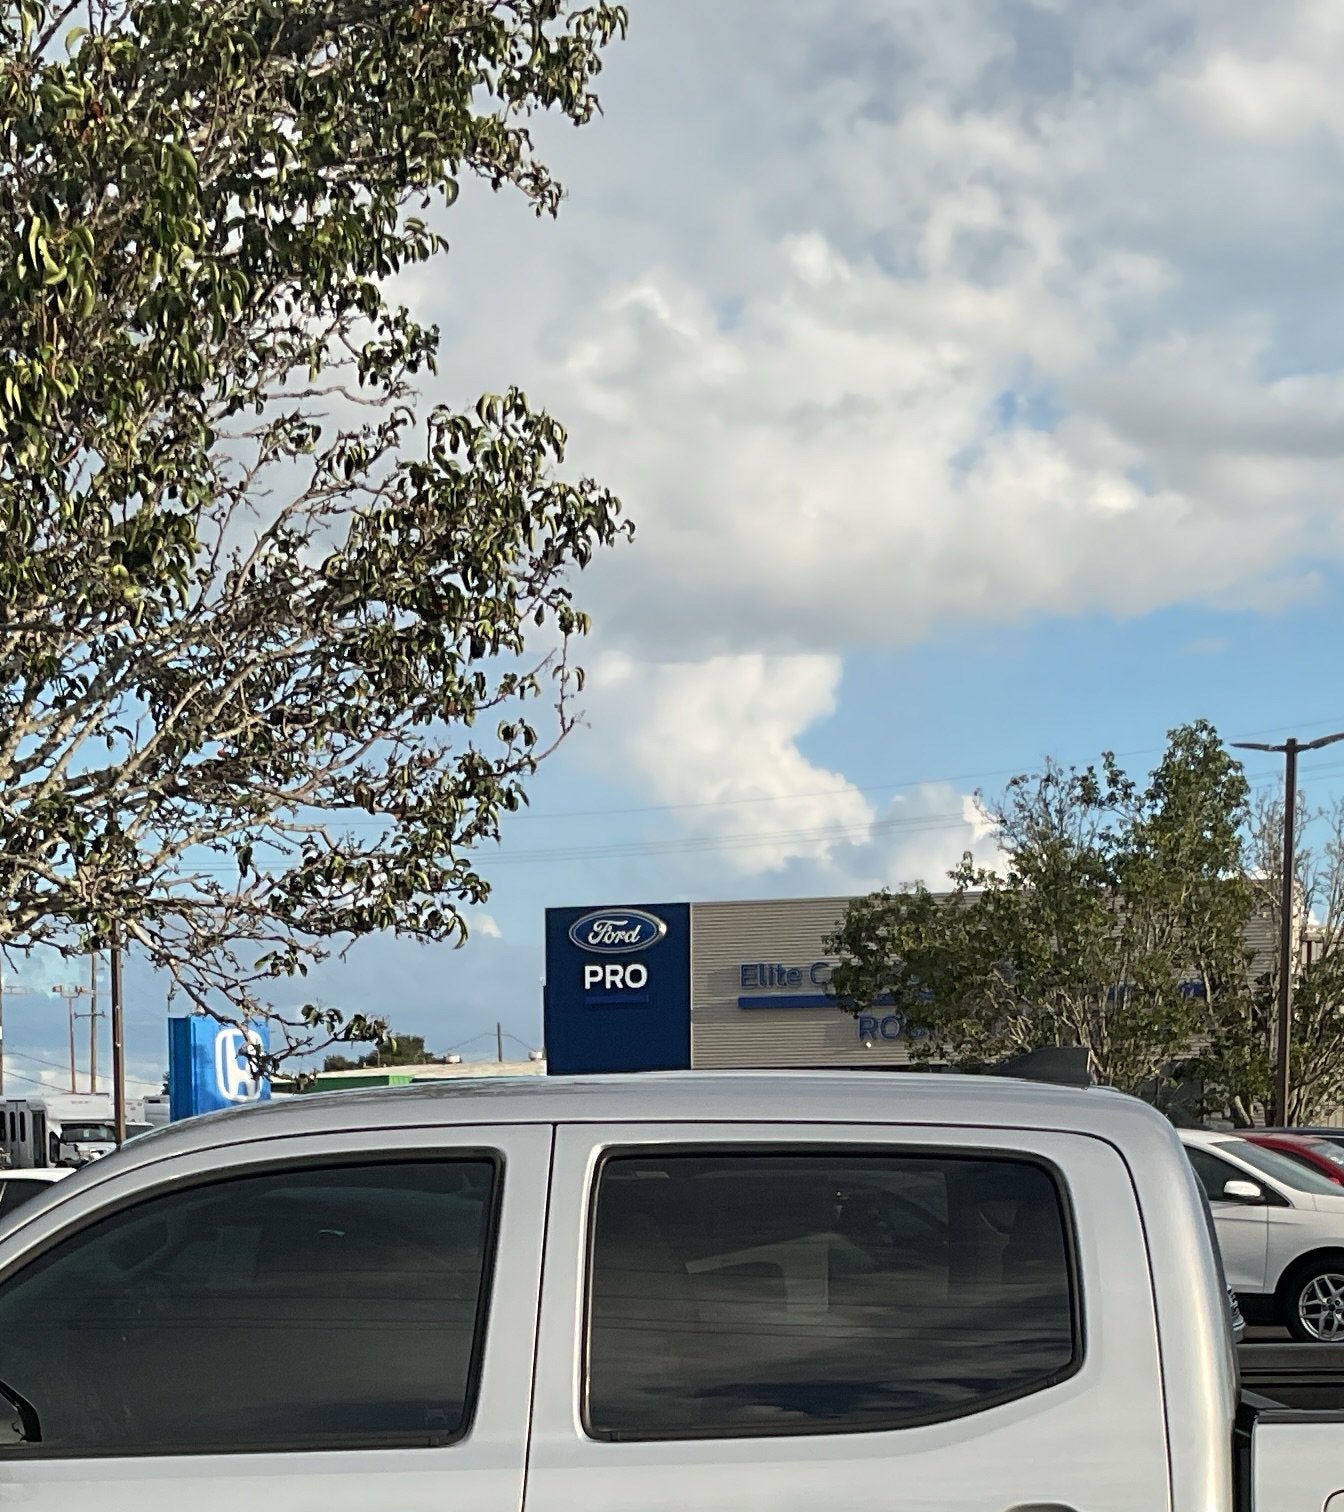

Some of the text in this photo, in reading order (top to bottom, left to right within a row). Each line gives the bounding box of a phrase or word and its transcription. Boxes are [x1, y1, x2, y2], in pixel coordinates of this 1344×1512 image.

[588, 919, 642, 945] Ford
[584, 963, 648, 989] PRO
[740, 963, 803, 988] Elite
